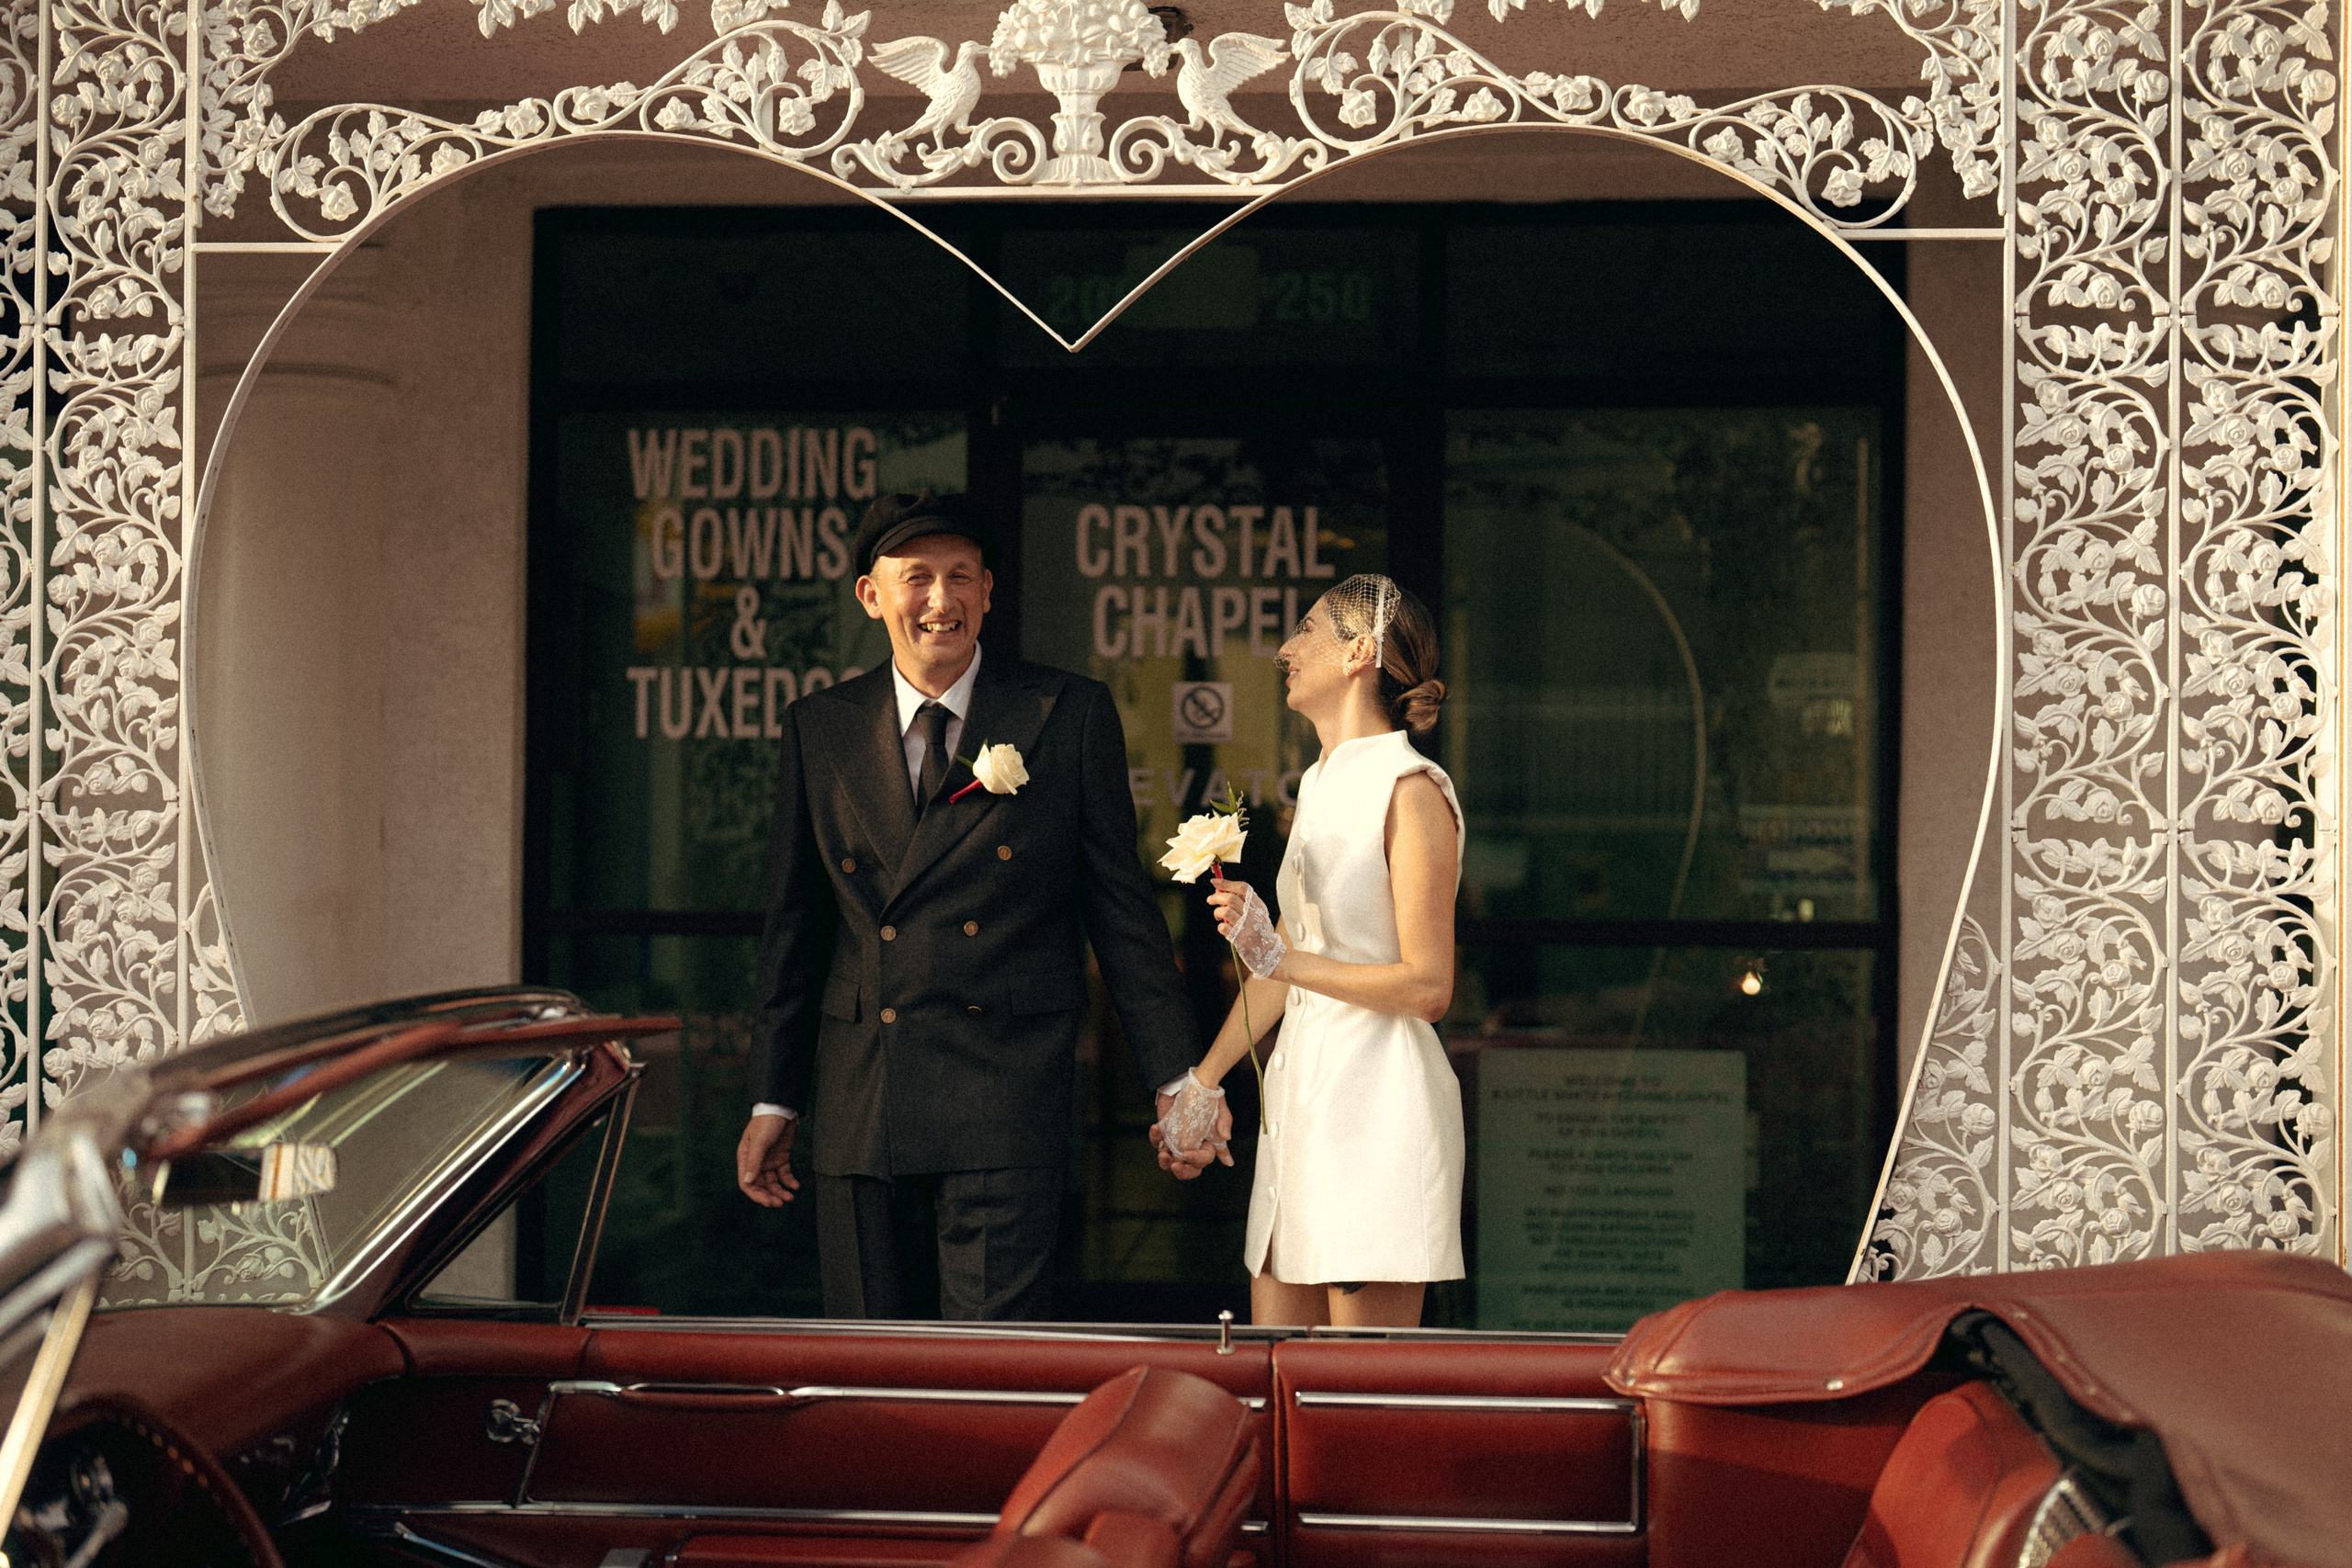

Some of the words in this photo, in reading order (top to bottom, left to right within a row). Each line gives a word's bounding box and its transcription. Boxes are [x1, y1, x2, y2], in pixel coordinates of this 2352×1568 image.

[628, 427, 876, 500] WEDDING
[652, 507, 851, 580] GOWNS
[1076, 504, 1335, 578] CRYSTAL
[730, 586, 767, 660] &
[626, 666, 865, 739] TUXED
